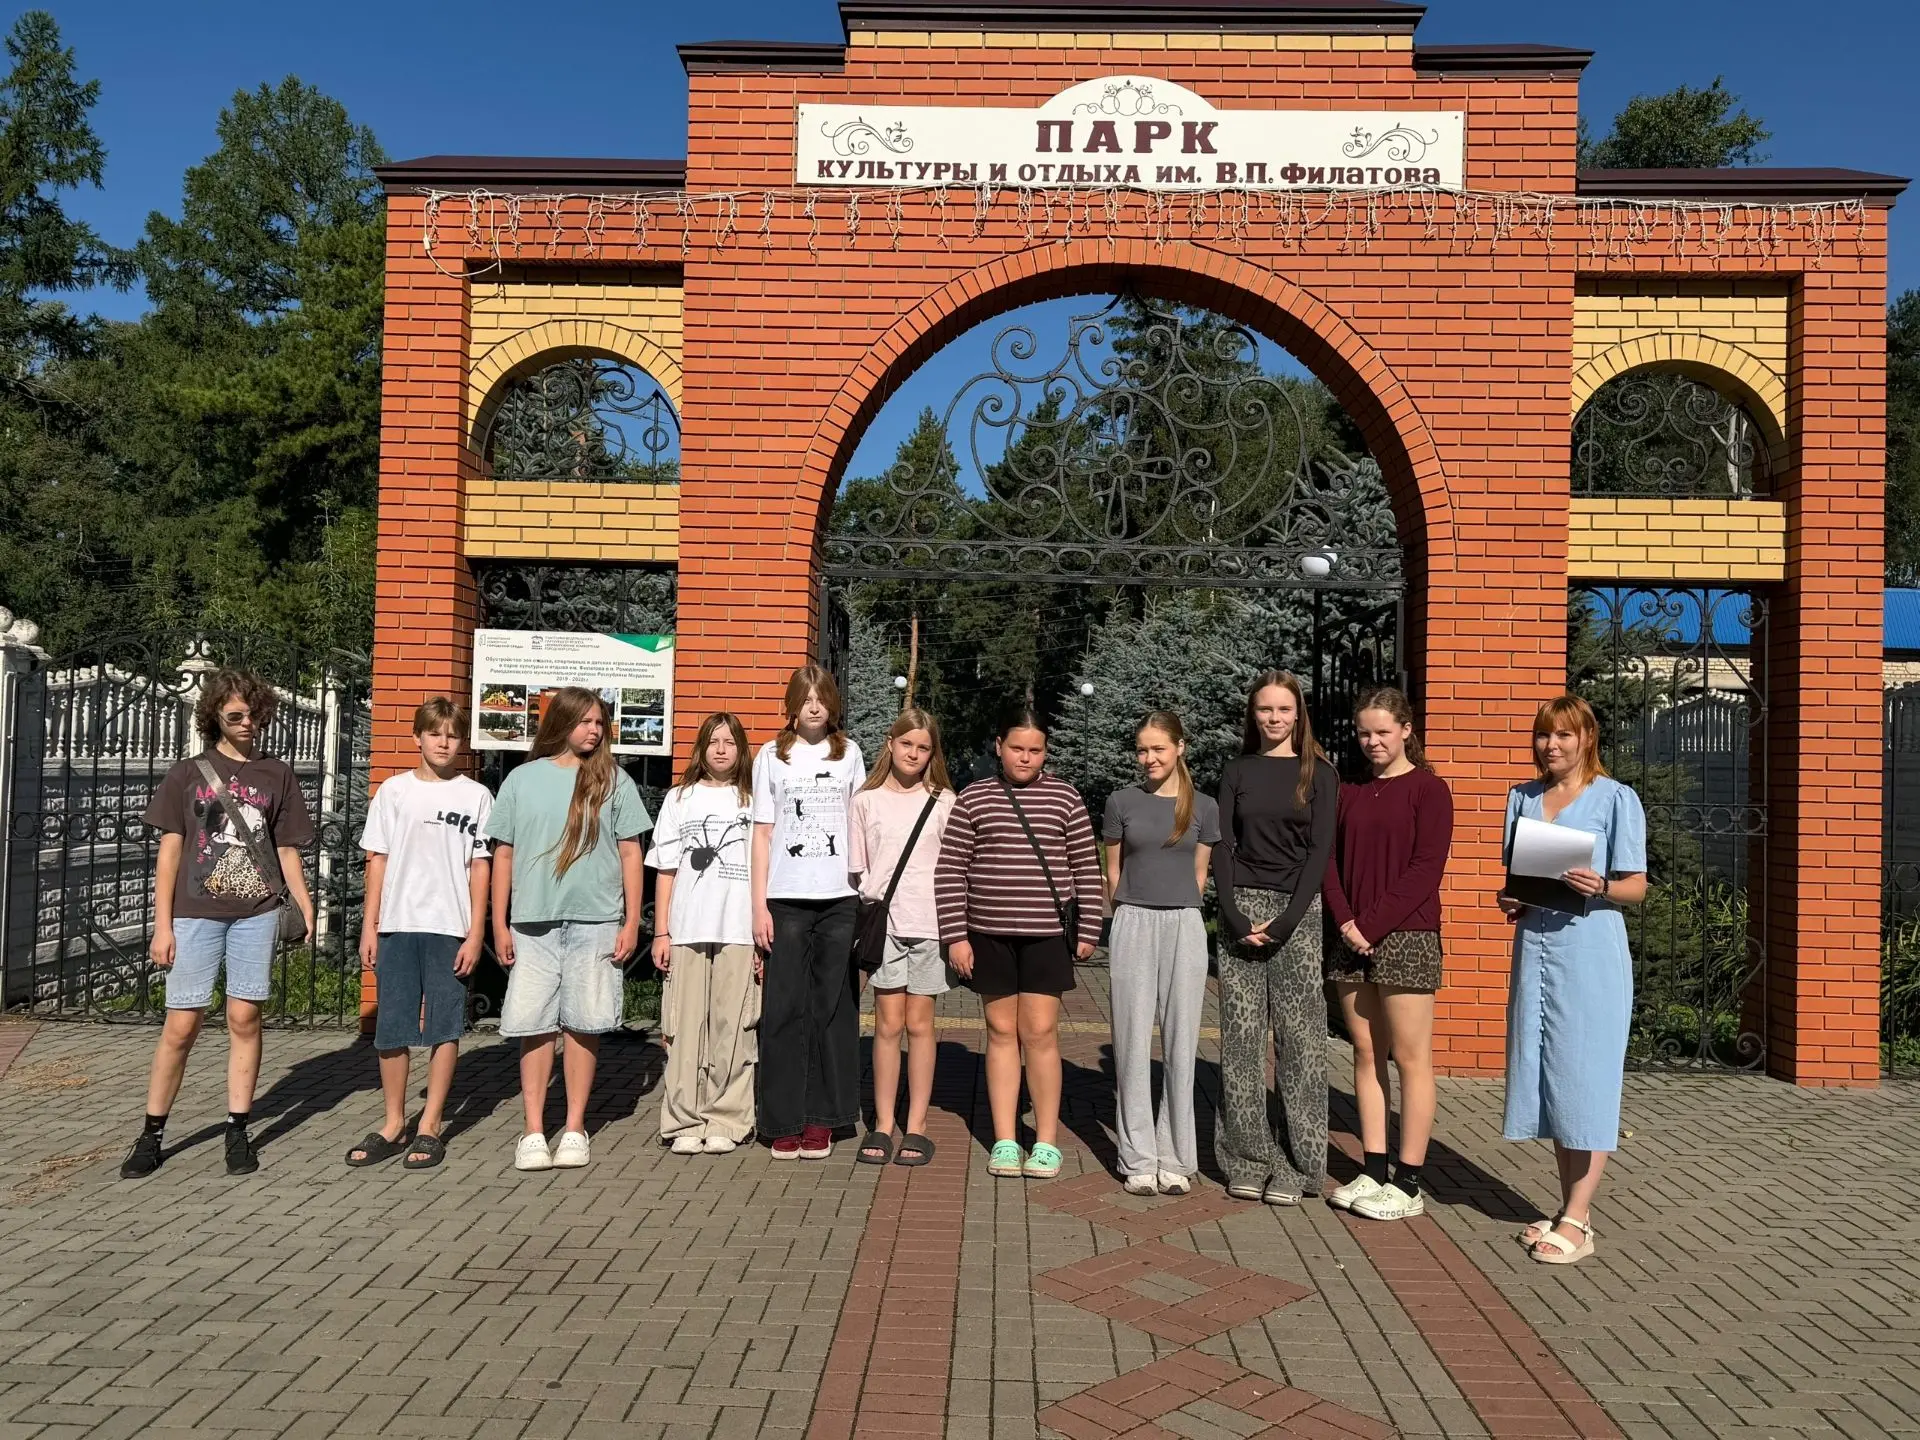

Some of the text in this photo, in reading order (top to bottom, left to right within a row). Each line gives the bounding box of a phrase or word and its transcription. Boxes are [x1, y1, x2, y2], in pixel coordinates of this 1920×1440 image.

[1035, 120, 1218, 154] ПАРК
[817, 159, 1441, 185] КУЛЬТУРЫ И ОТДЫХА им. В.П. Филатова
[1379, 1209, 1406, 1218] crocs
